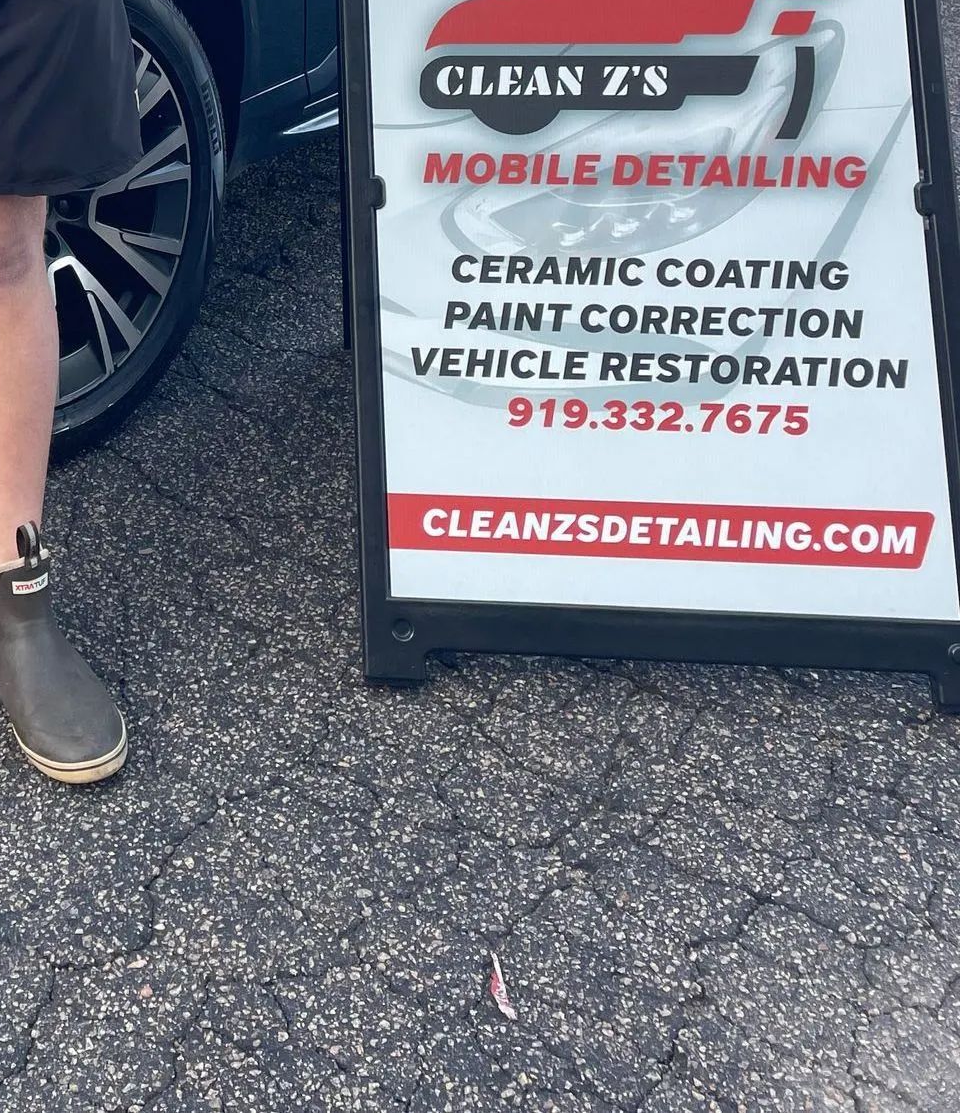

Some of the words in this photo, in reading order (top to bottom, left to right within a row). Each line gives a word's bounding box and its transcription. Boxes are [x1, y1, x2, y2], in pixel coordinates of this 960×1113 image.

[436, 65, 584, 96] CLEAN
[602, 65, 669, 97] Z'S
[423, 153, 599, 185] MOBILE
[612, 155, 867, 189] DETAILING
[450, 254, 646, 287] CERAMIC
[656, 258, 850, 291] COATING
[443, 300, 572, 333] PAINT
[580, 304, 864, 339] CORRECTION
[410, 346, 589, 381] VEHICLE
[598, 352, 909, 390] RESTORATION
[507, 397, 810, 436] 919.332.7675
[422, 508, 917, 555] CLEANZSDETAILING.COM
[15, 577, 46, 591] XTRATUF
